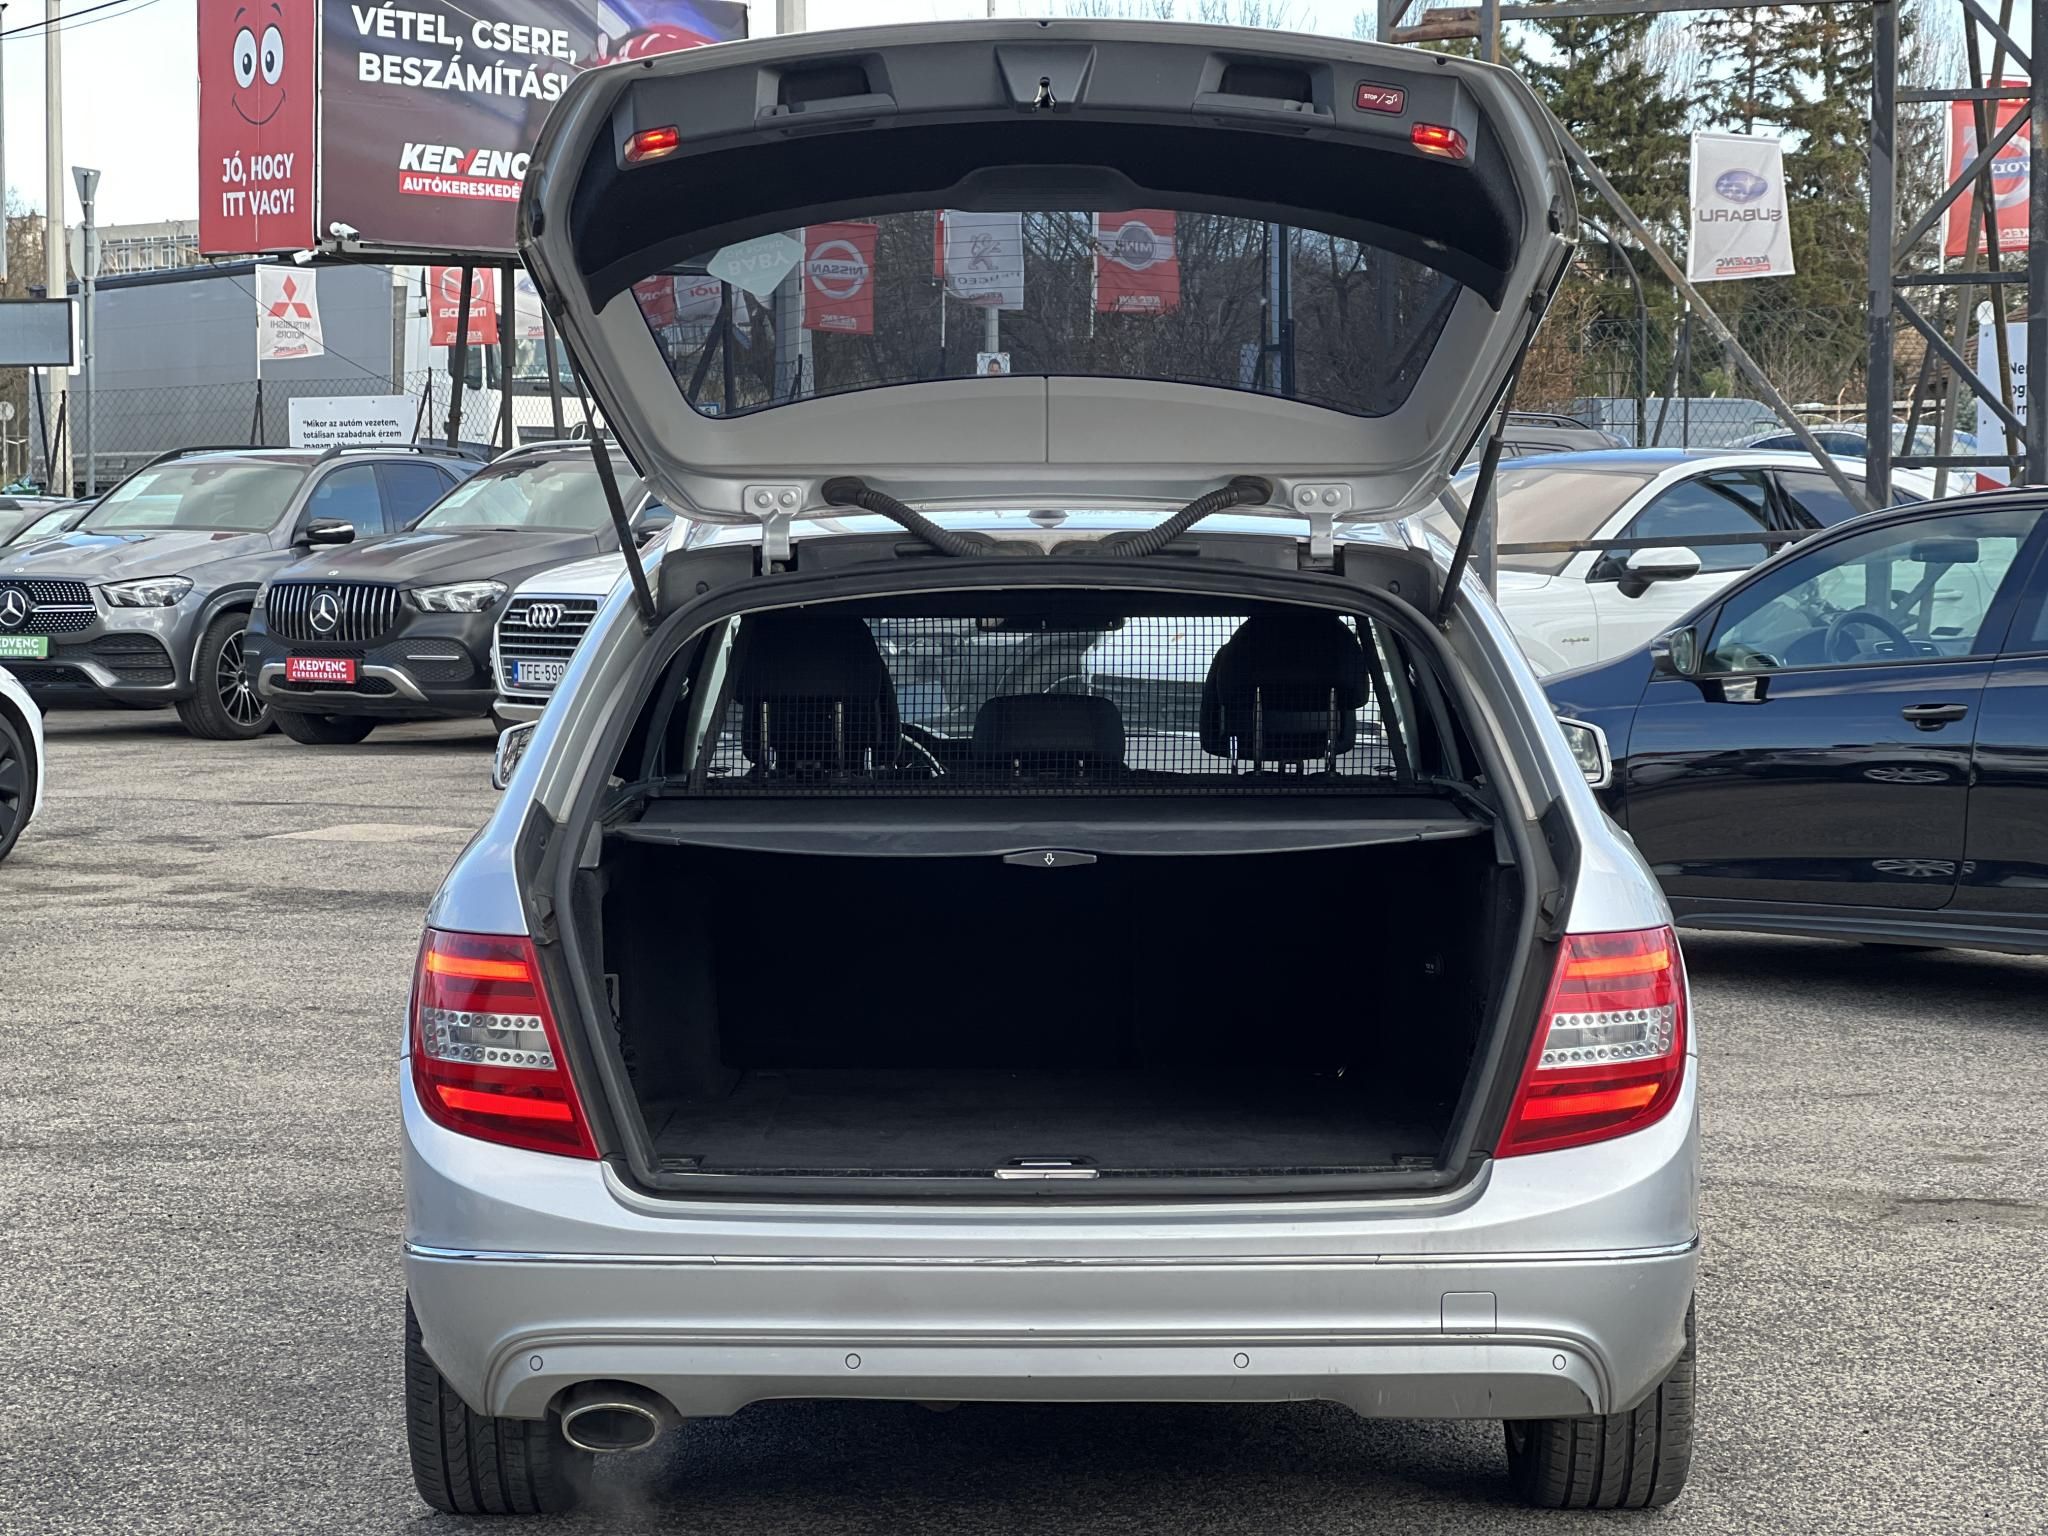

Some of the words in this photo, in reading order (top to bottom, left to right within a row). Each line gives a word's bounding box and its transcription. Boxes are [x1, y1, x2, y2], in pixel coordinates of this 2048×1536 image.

[351, 1, 463, 51] VÉTEL,
[471, 20, 577, 65] CSERE,
[359, 52, 568, 100] BESZÁMÍTÁS!
[222, 151, 247, 186] JÓ,
[251, 153, 294, 181] HOGY
[403, 176, 522, 198] AUTÓKERESKEDÉ
[222, 192, 246, 217] ITT
[249, 188, 295, 215] VAGY!
[303, 430, 335, 439] totálisan
[336, 429, 376, 438] szabadnak
[378, 430, 402, 438] érzem
[339, 419, 363, 427] autóm
[365, 419, 399, 428] vezetem,
